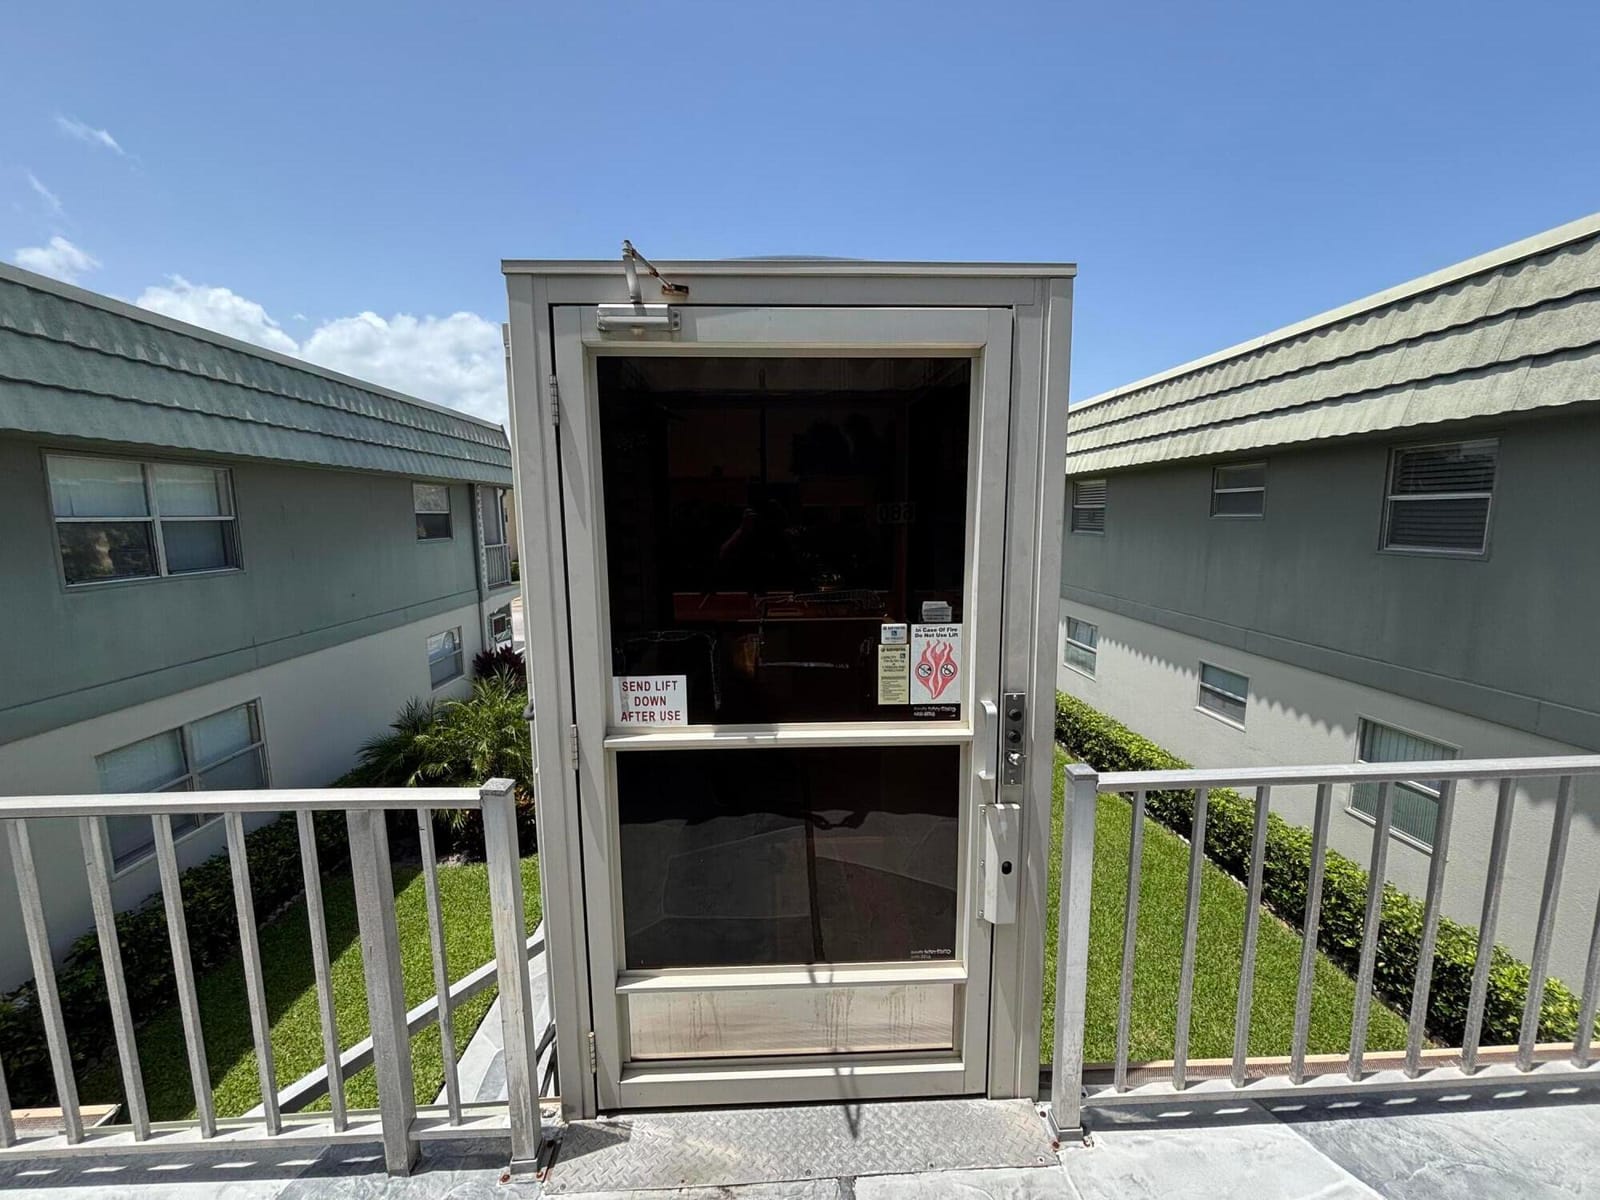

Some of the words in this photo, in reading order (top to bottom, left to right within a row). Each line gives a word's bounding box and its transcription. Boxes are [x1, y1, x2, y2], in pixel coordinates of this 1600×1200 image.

[622, 681, 651, 692] SEND
[655, 680, 678, 691] LIFT
[634, 696, 667, 707] DOWN
[620, 711, 656, 722] AFTER
[660, 710, 681, 721] USE
